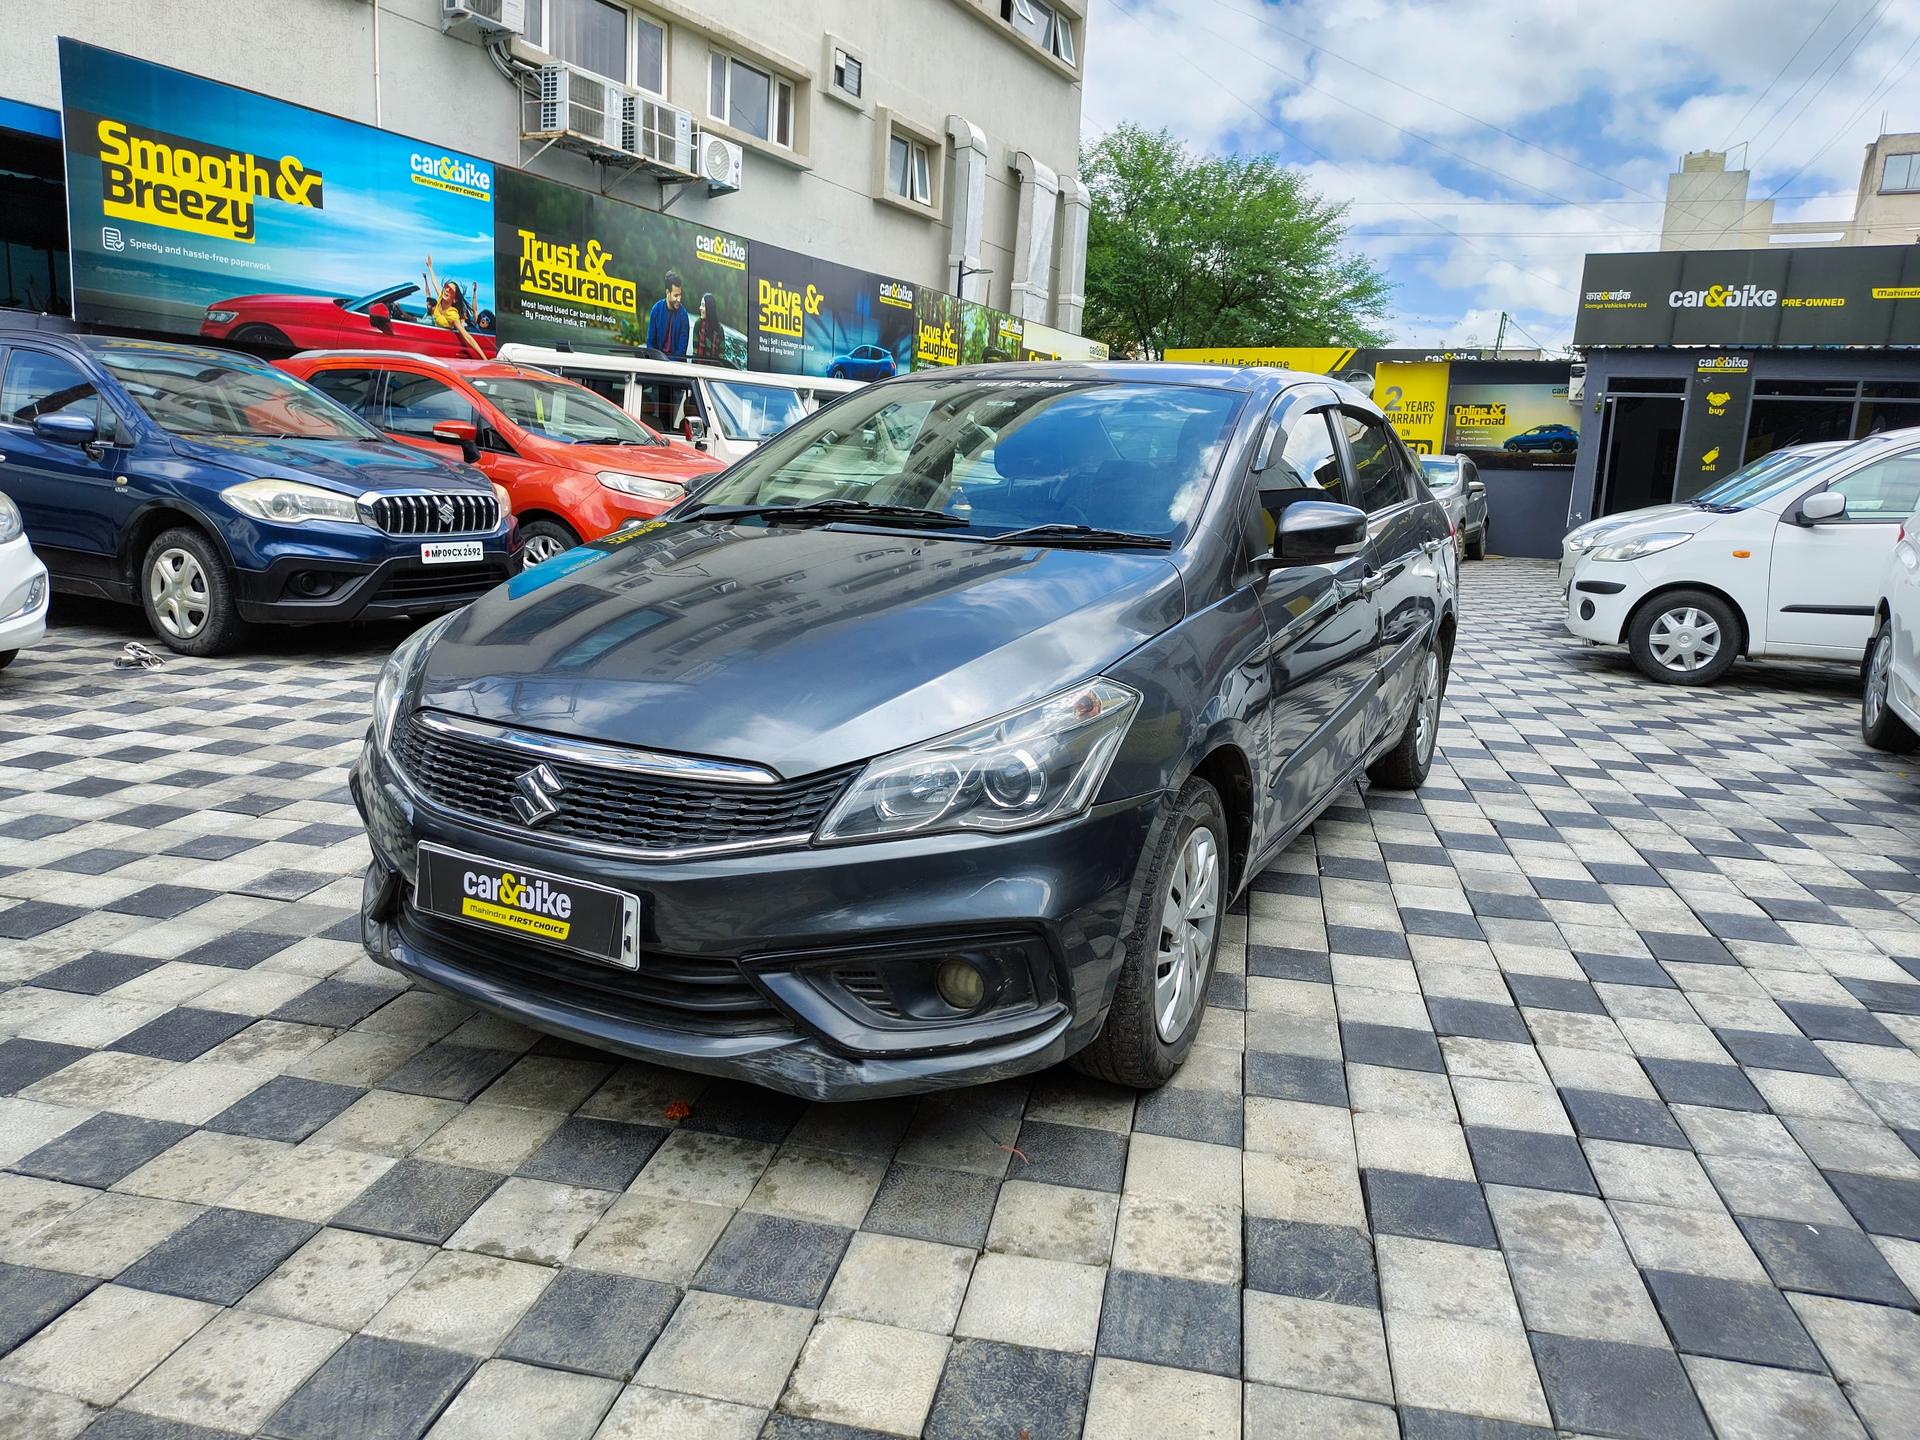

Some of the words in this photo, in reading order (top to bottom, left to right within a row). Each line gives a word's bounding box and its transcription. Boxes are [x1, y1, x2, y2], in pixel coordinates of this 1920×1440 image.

[98, 120, 269, 198] Smooth
[276, 155, 322, 207] &
[410, 153, 490, 190] car&bike
[102, 161, 255, 239] Breezy
[445, 184, 463, 193] FIRST
[463, 188, 485, 199] CHOICE
[130, 238, 163, 254] Speedy
[165, 246, 181, 256] and
[183, 249, 229, 265] hassle-free
[231, 258, 272, 272] paperwork
[518, 229, 580, 271] Trust
[584, 239, 613, 277] &
[696, 235, 745, 261] car&bike
[521, 259, 634, 308] Assurance
[879, 283, 913, 302] car&bike
[1668, 284, 1777, 307] car&bike
[1781, 298, 1845, 307] PRE-OWNED
[759, 279, 801, 311] Drive
[804, 283, 824, 315] &
[521, 299, 537, 309] Most
[537, 302, 553, 313] loved
[554, 305, 569, 316] Used
[569, 308, 579, 317] Car
[580, 310, 596, 321] brand
[596, 313, 603, 321] of
[603, 315, 616, 325] India
[525, 310, 534, 320] By
[535, 311, 562, 325] Franchise
[580, 320, 588, 328] ET
[759, 303, 801, 333] Smile
[918, 319, 941, 343] Love
[780, 340, 798, 350] Exchange
[1238, 358, 1290, 369] Exchange
[1698, 357, 1748, 368] car&bike
[1384, 386, 1403, 411] 2
[1405, 401, 1435, 413] YEARS
[1454, 404, 1487, 415] Online
[1709, 406, 1725, 416] buy
[1460, 414, 1506, 426] On-road
[1401, 429, 1411, 437] ON
[464, 547, 481, 557] 2592
[463, 871, 572, 919] car&bike
[470, 905, 506, 919] Mahindra
[509, 915, 533, 927] FIRST
[534, 921, 564, 934] CHOICE
